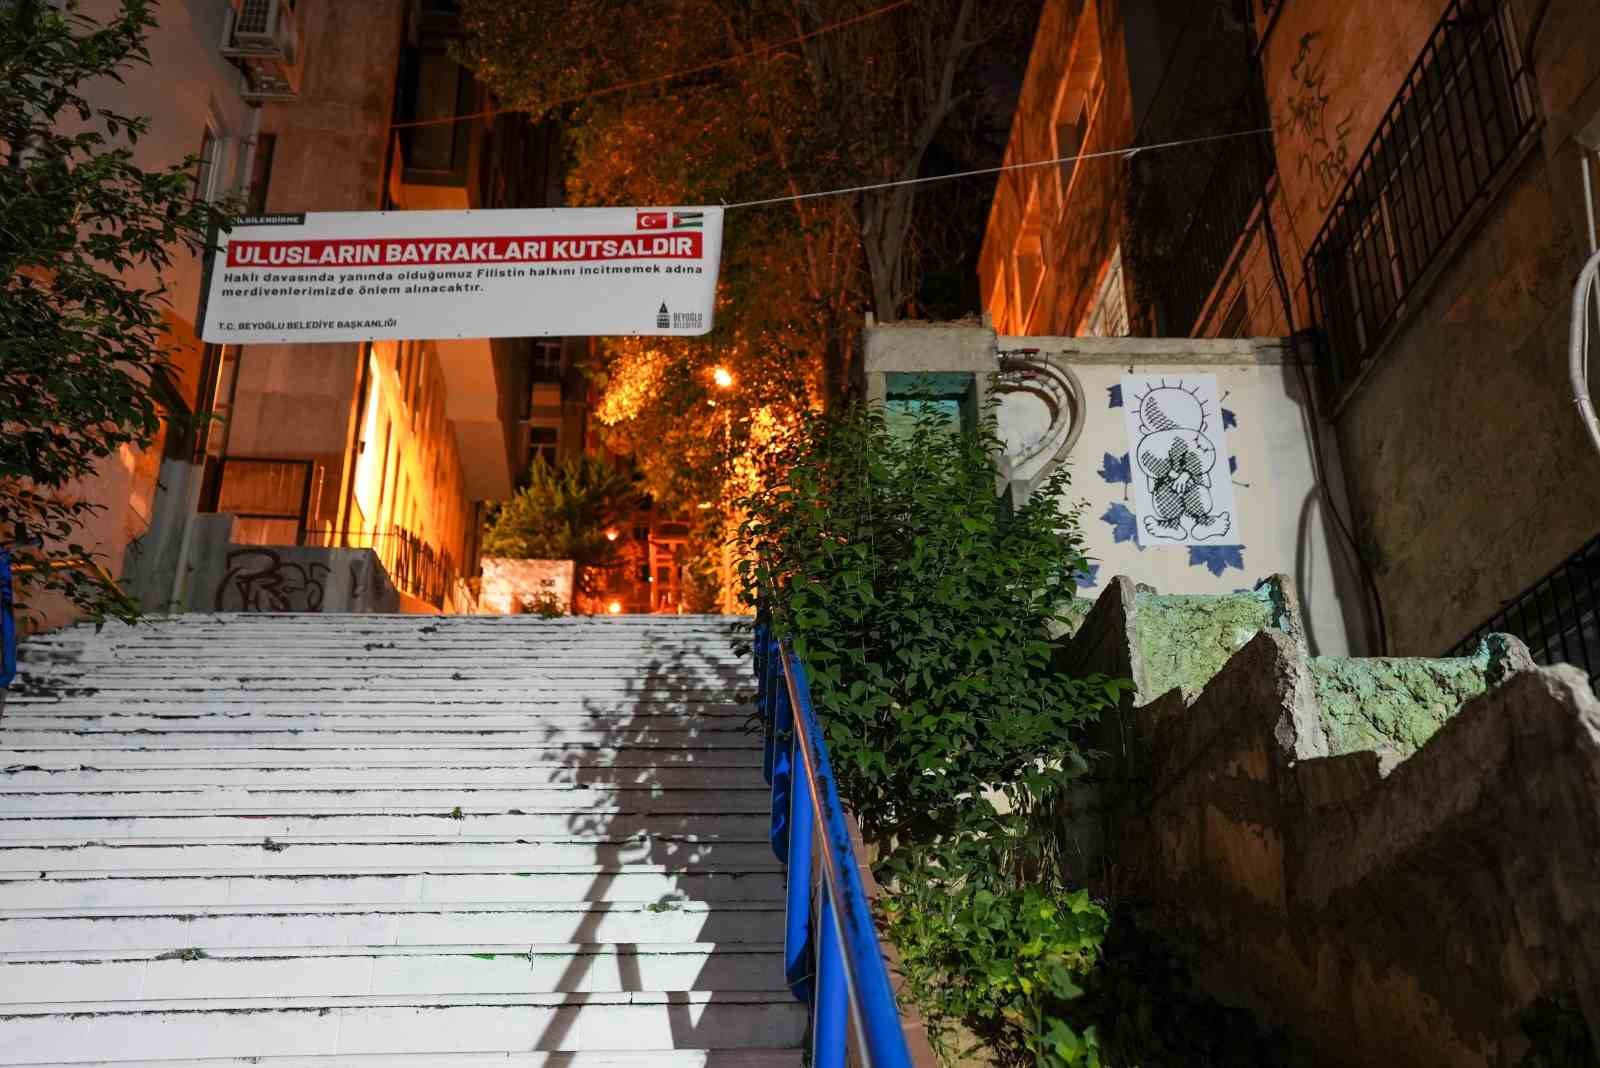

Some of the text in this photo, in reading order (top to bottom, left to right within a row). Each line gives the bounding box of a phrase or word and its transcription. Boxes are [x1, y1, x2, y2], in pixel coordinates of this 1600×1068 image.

[235, 237, 693, 265] ULUSLARIN BAYRAKLARI KUTSALDIR
[224, 264, 703, 283] Haklı davasında yanında olduğumuz Filistin halkını incitmemek adına
[222, 282, 484, 297] merdivenlerimizde önlem alınacaktır.
[218, 317, 397, 331] T.C. BEYOĞLU BELEDİYE BAŞKANLIĞI
